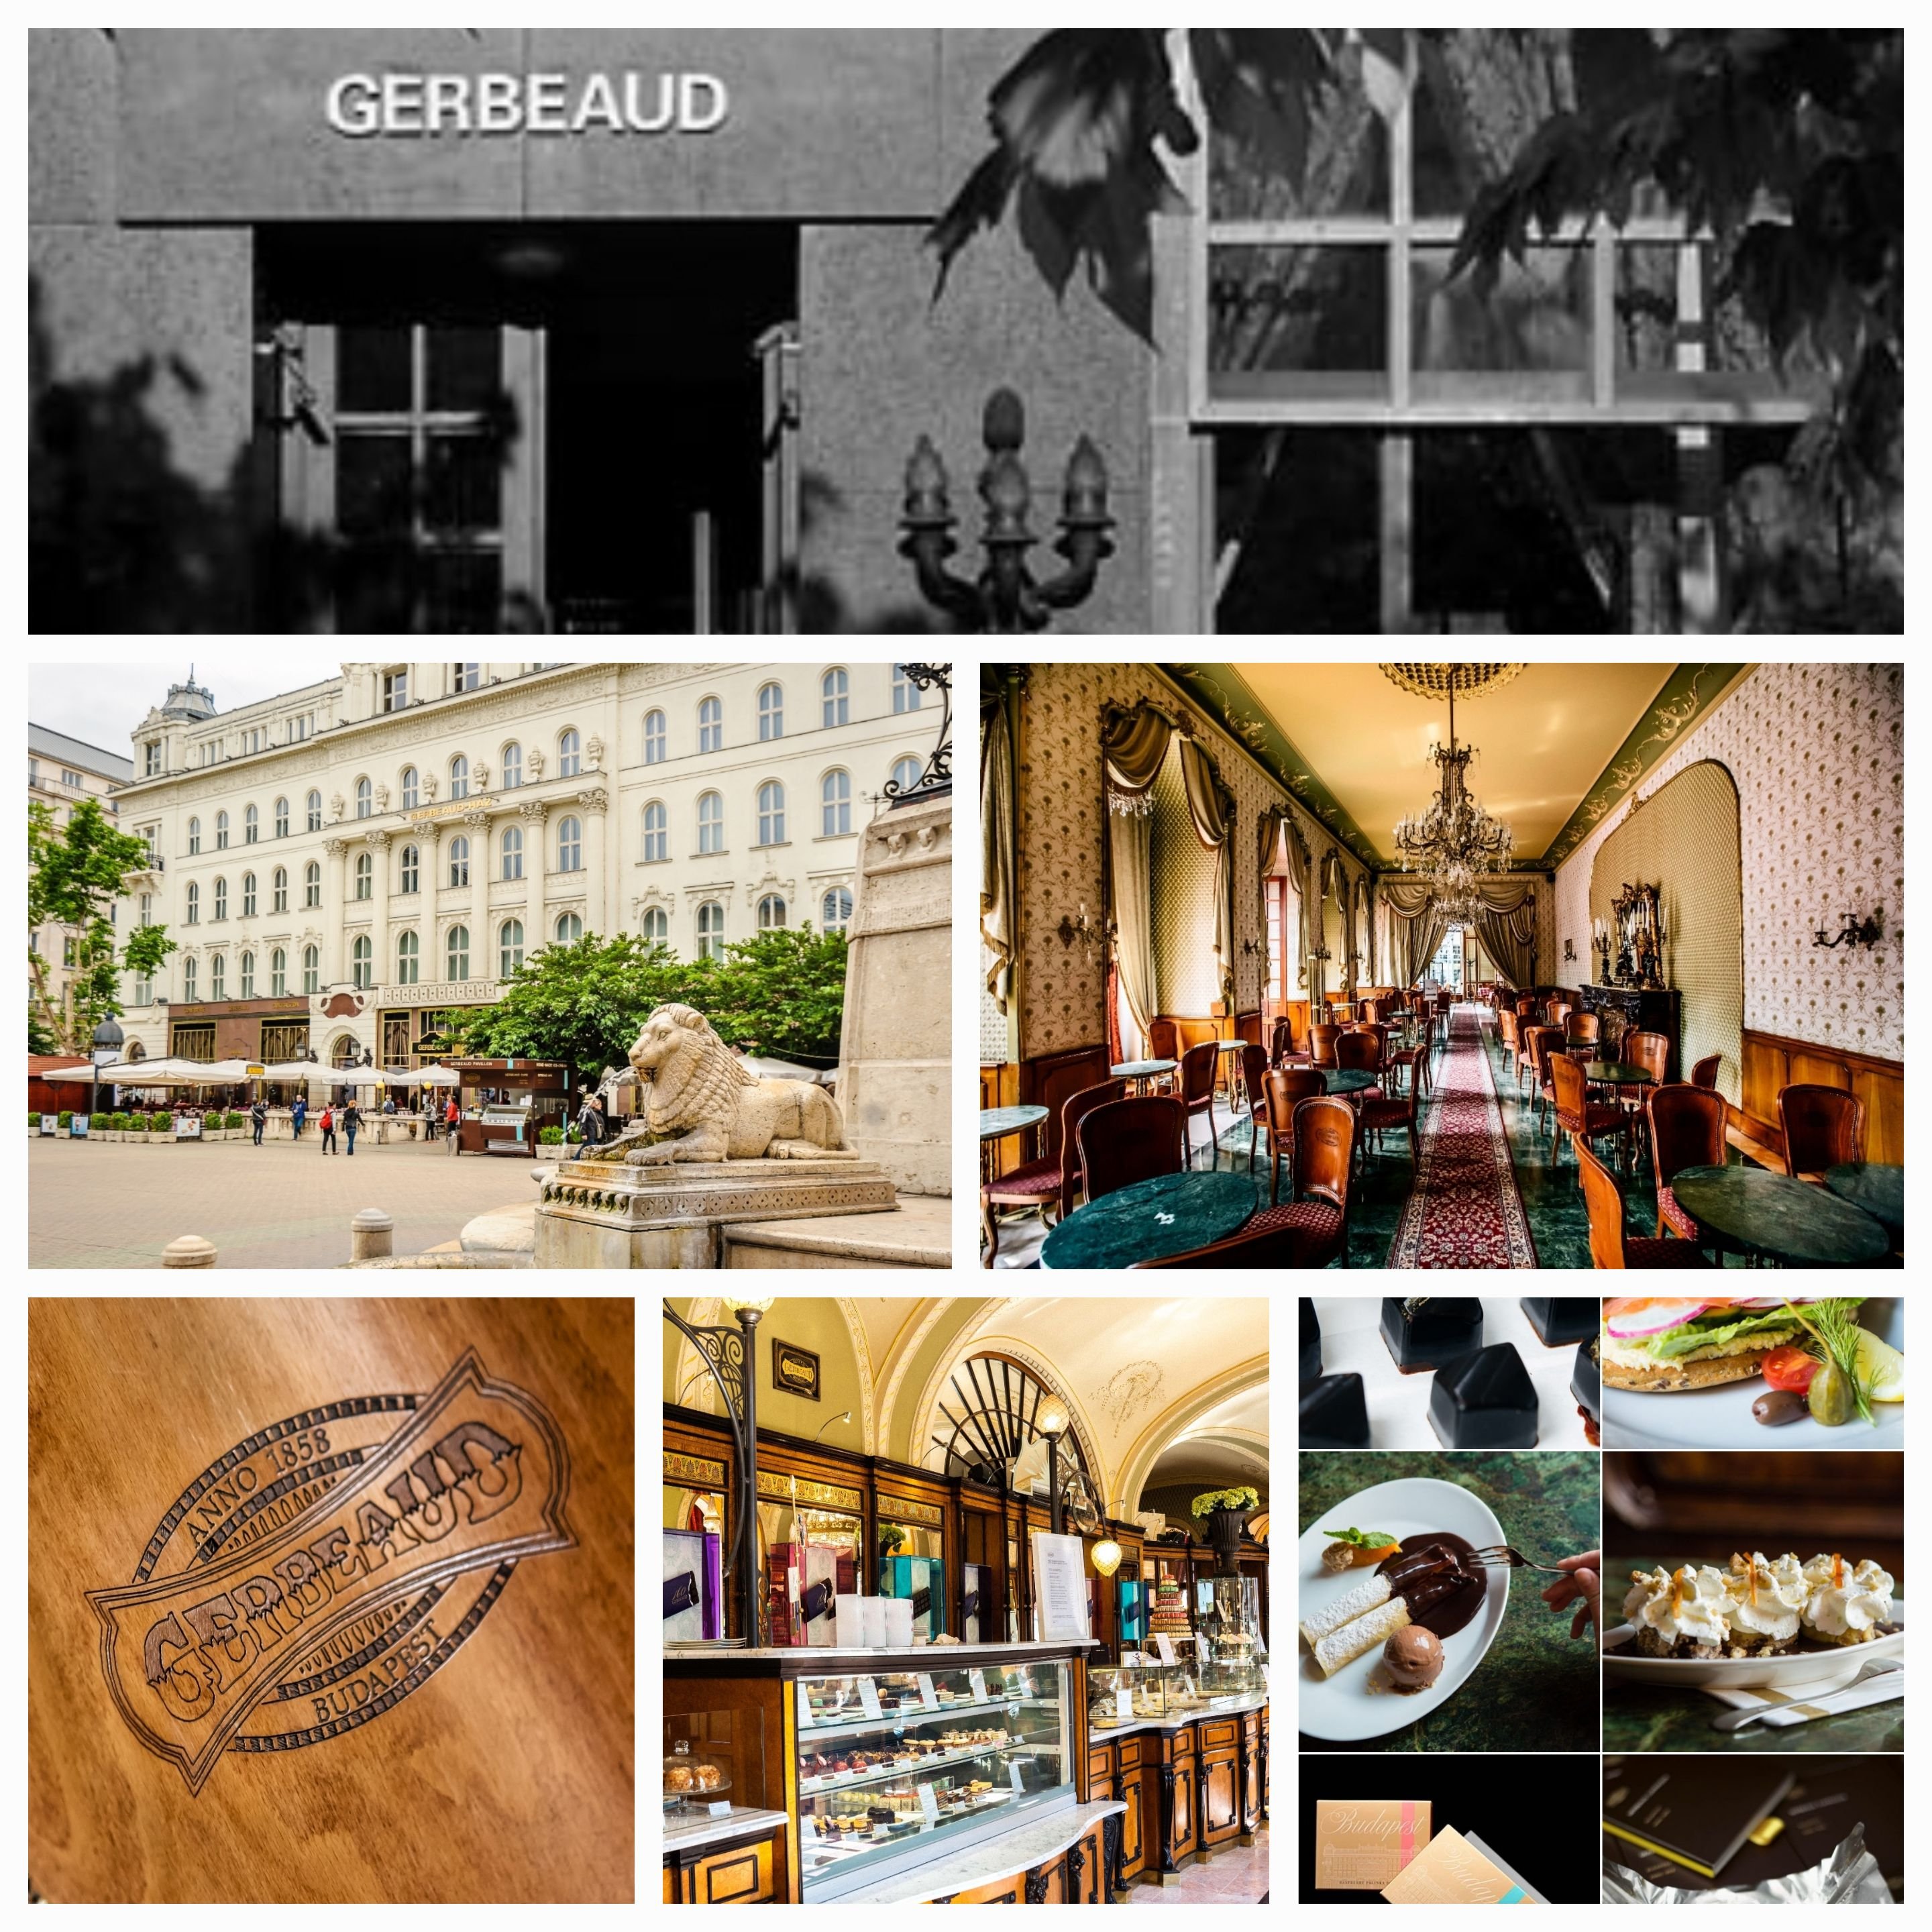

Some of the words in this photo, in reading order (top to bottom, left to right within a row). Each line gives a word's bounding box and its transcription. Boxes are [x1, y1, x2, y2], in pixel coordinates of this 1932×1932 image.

[326, 71, 729, 135] GERBEAUD
[784, 1362, 813, 1379] GERBEAUD
[186, 1466, 258, 1549] ANNO
[266, 1428, 331, 1477] 1858
[143, 1421, 523, 1723] GERBEAUD
[311, 1617, 445, 1724] BUDAPEST
[1320, 1806, 1428, 1841] Budapest
